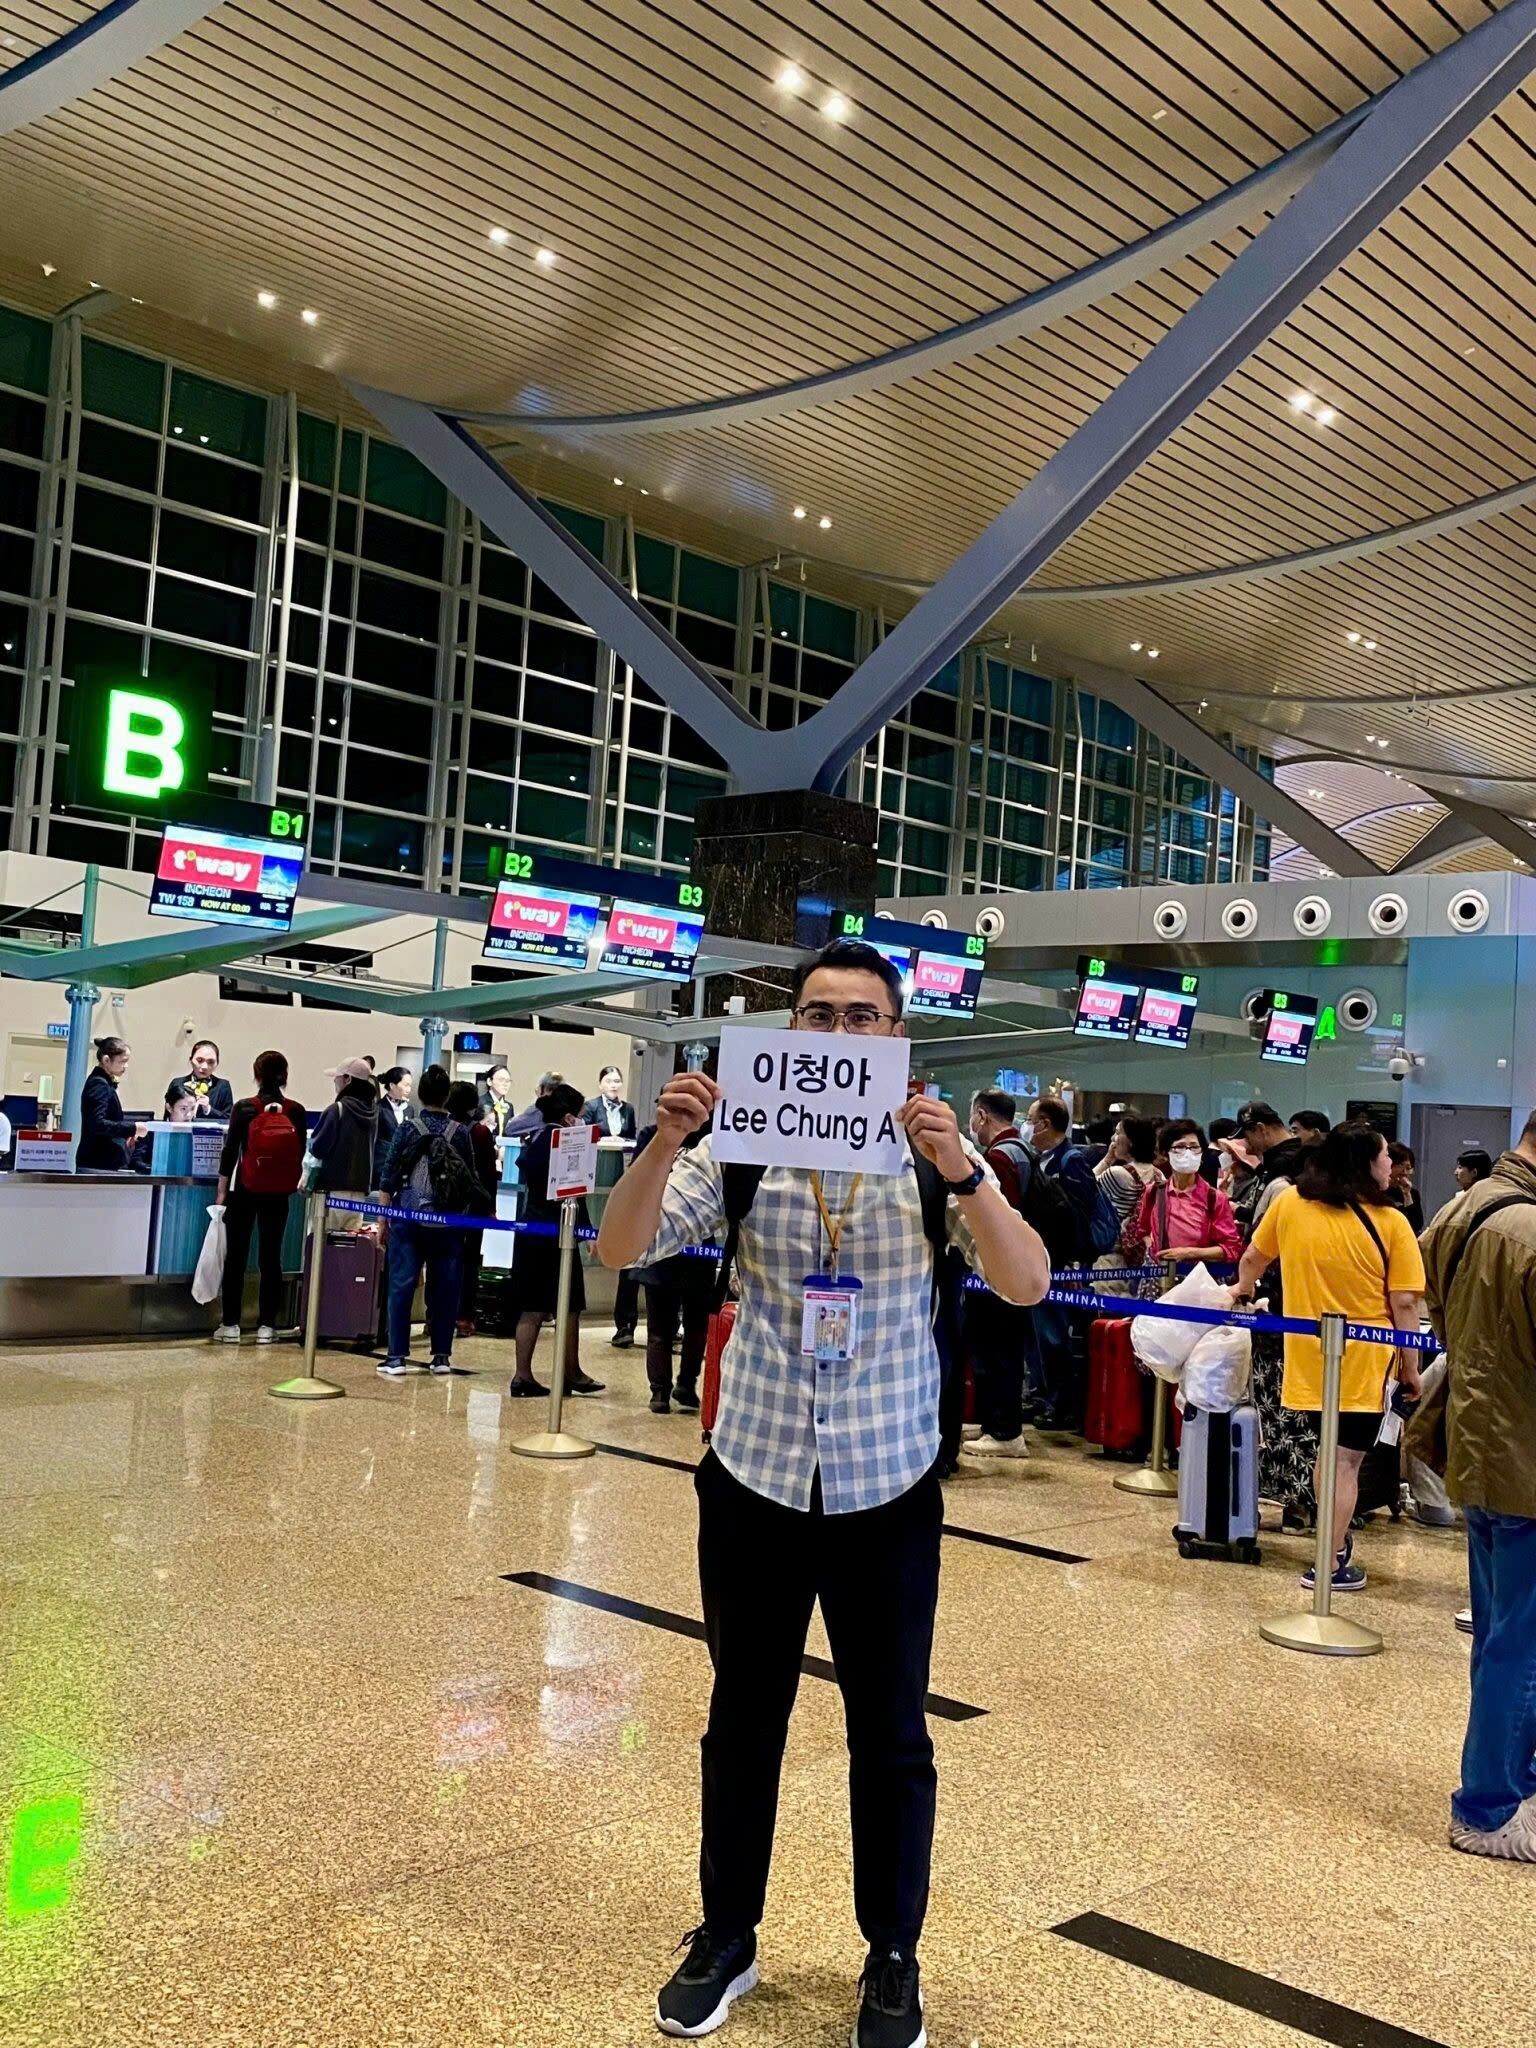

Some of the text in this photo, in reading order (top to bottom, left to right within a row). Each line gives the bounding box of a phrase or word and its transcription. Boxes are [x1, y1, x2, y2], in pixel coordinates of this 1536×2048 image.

[103, 689, 184, 799] B
[270, 810, 303, 838] B1
[505, 852, 533, 878] B2
[184, 883, 232, 899] INCHEON
[679, 884, 703, 907] B3
[158, 892, 176, 904] TW
[201, 900, 220, 909] NOW
[220, 902, 231, 910] AT
[843, 914, 864, 935] B4
[490, 937, 504, 948] TW
[510, 929, 545, 942] INCHEON
[622, 945, 654, 958] INCHEON
[966, 936, 985, 956] B5
[605, 953, 617, 962] TW
[1088, 959, 1105, 977] B6
[1181, 975, 1197, 992] B7
[49, 1025, 69, 1036] EXIT
[1315, 1006, 1336, 1040] A
[753, 1052, 872, 1097] 이청아
[719, 1099, 897, 1151] Lee Chung A
[352, 1203, 406, 1218] INTERNATIONAL
[411, 1211, 447, 1224] TERMINAL
[1086, 1268, 1145, 1280] INTERNATIONAL
[1044, 1290, 1106, 1308] ERMINAL
